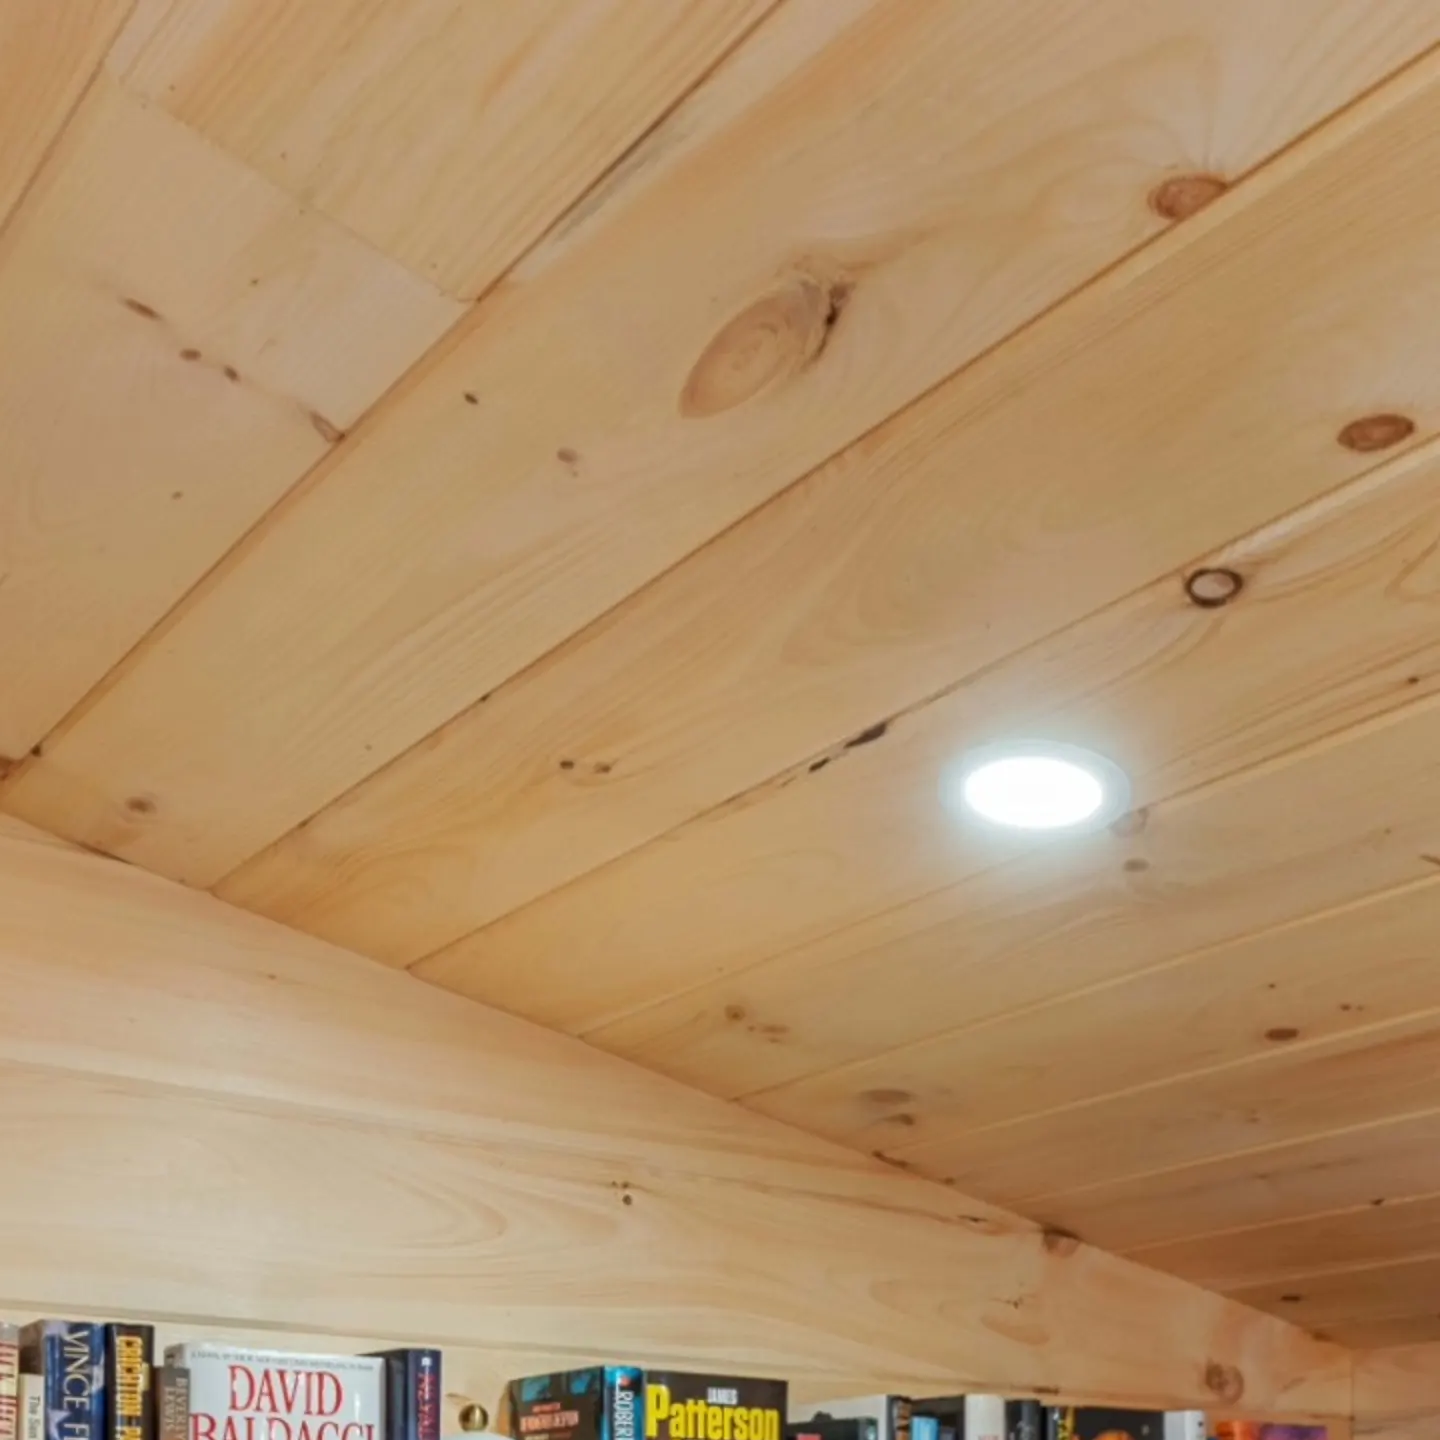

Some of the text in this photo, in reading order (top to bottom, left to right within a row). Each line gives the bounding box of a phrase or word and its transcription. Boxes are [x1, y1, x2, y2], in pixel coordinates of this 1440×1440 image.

[61, 1328, 90, 1411] VINCE
[115, 1335, 143, 1417] CRICHTON
[228, 1364, 344, 1418] DAVID
